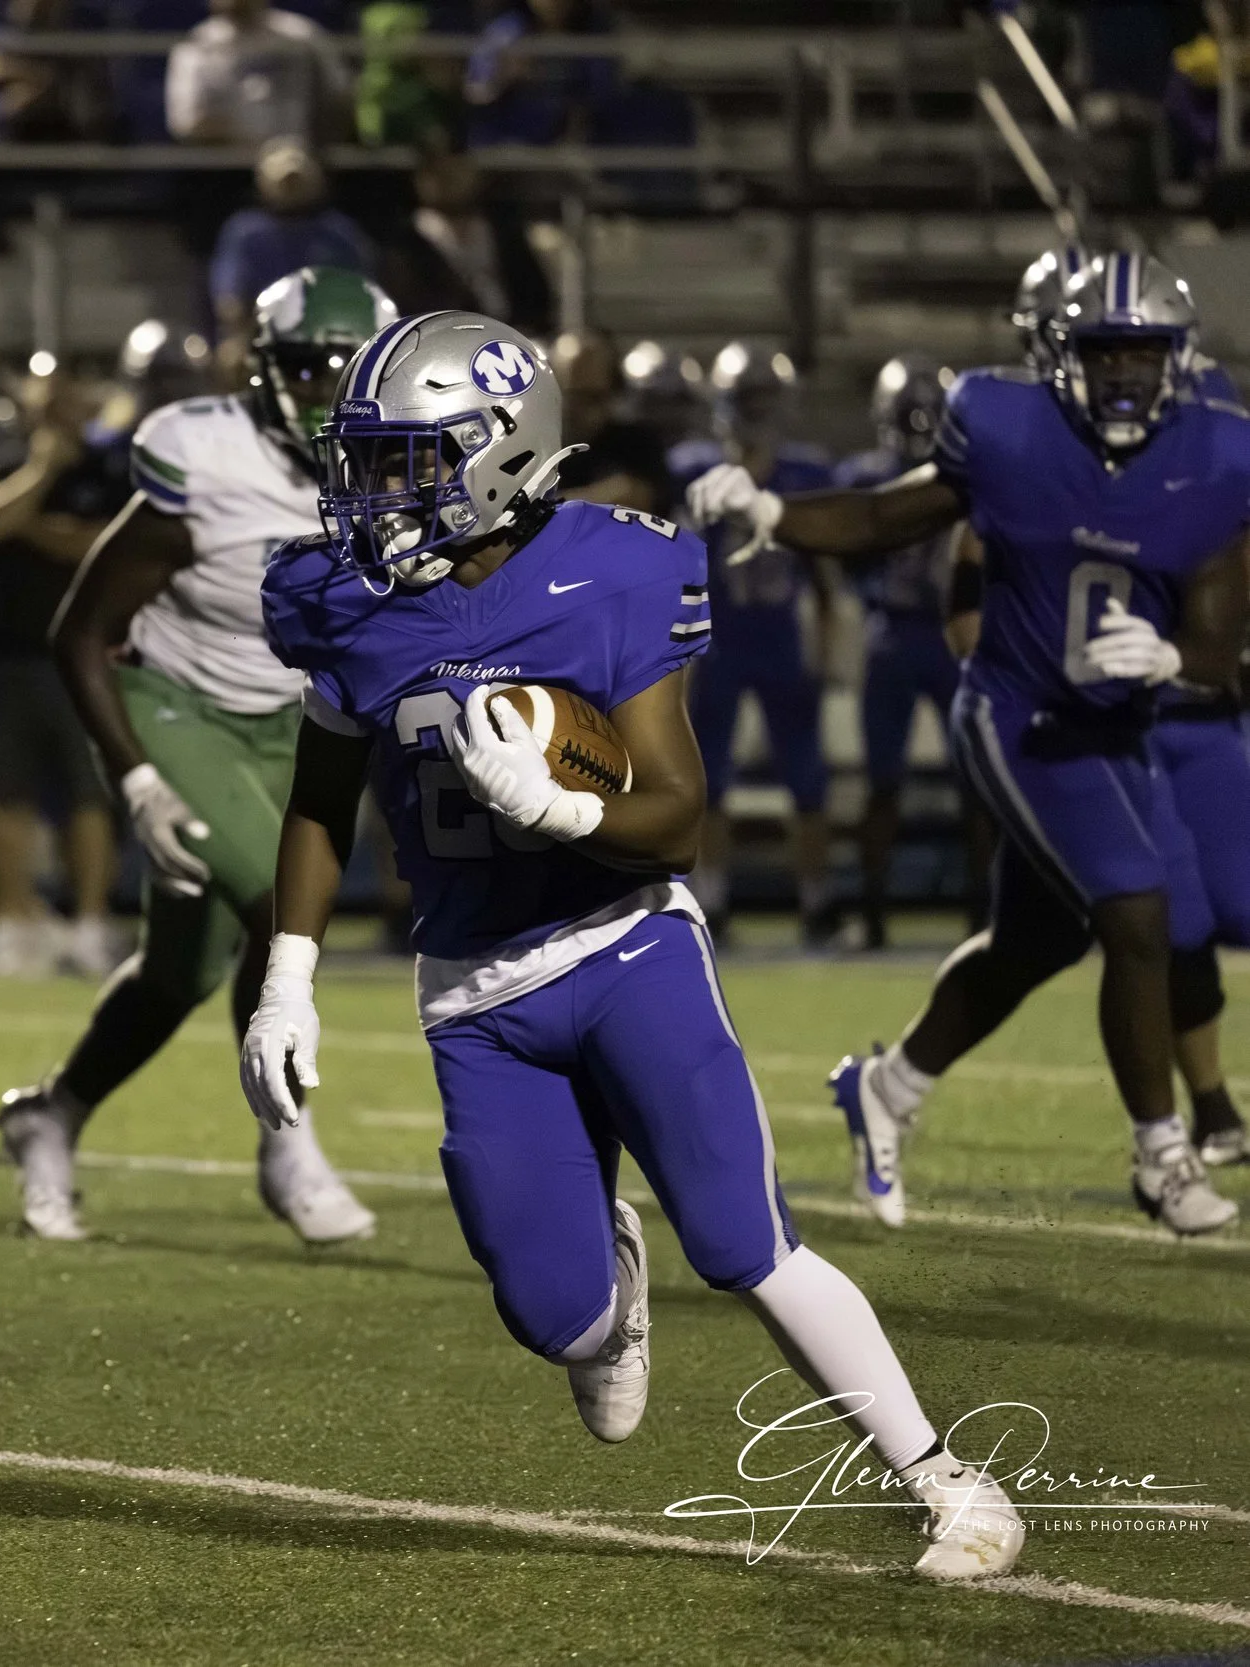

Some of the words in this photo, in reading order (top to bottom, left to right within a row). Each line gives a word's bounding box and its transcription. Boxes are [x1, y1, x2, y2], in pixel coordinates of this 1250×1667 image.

[473, 341, 535, 393] M
[339, 401, 373, 415] Vikings
[612, 506, 678, 541] 2
